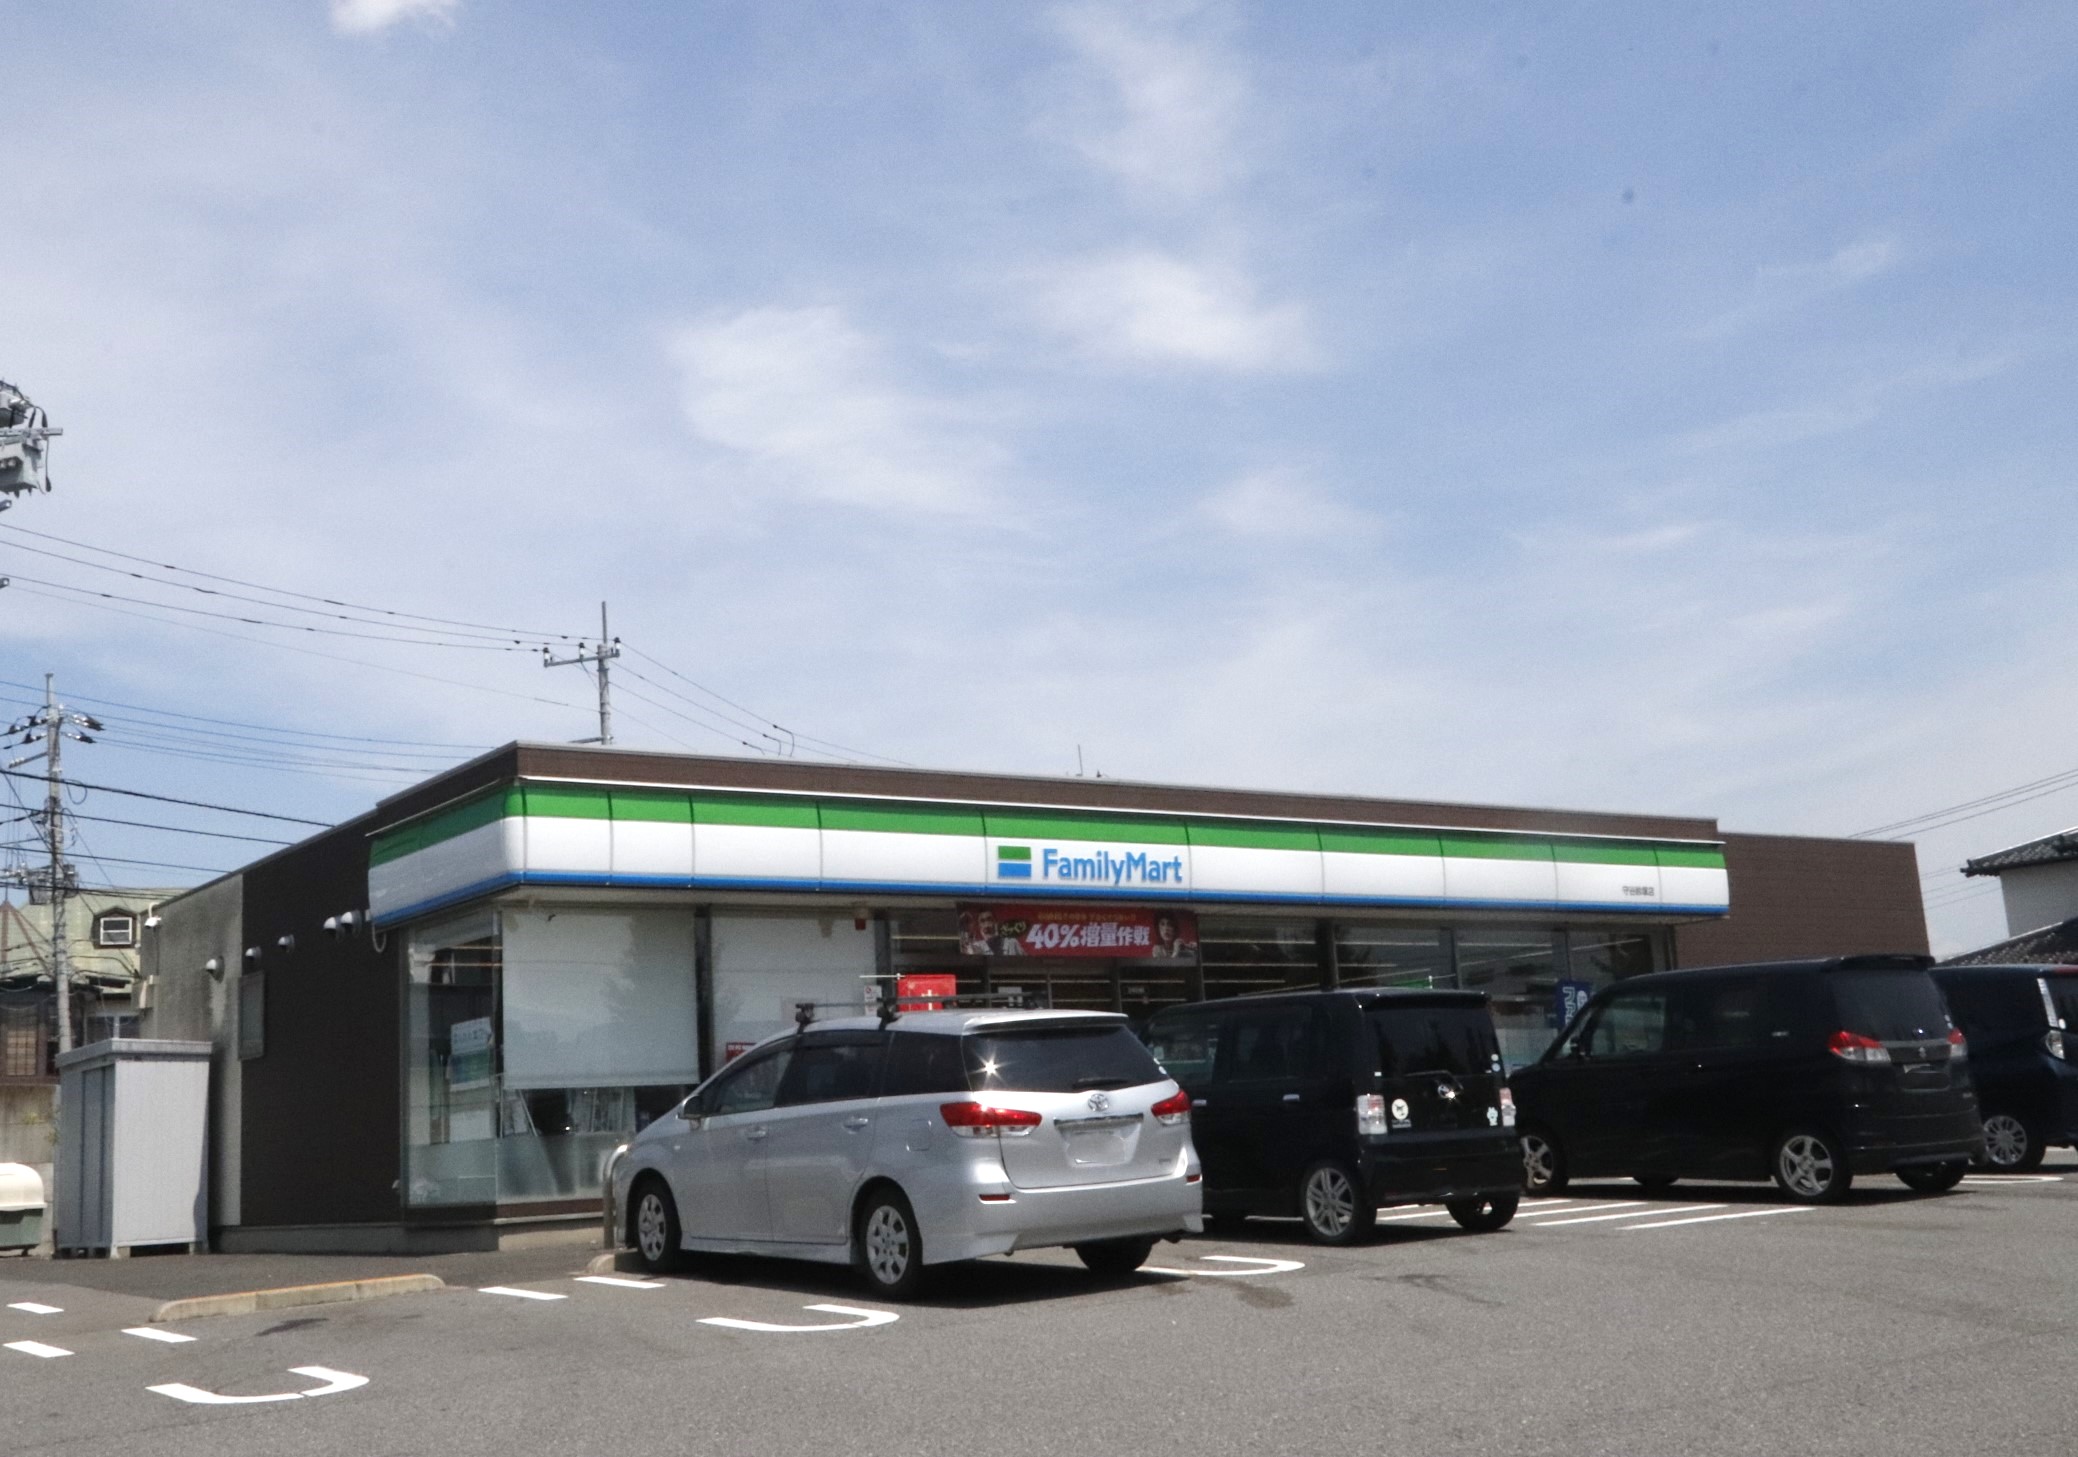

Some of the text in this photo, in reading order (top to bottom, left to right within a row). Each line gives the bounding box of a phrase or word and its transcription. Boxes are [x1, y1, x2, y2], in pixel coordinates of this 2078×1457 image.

[1043, 849, 1182, 885] FamilyMart
[1027, 922, 1150, 949] 40%増量作戦
